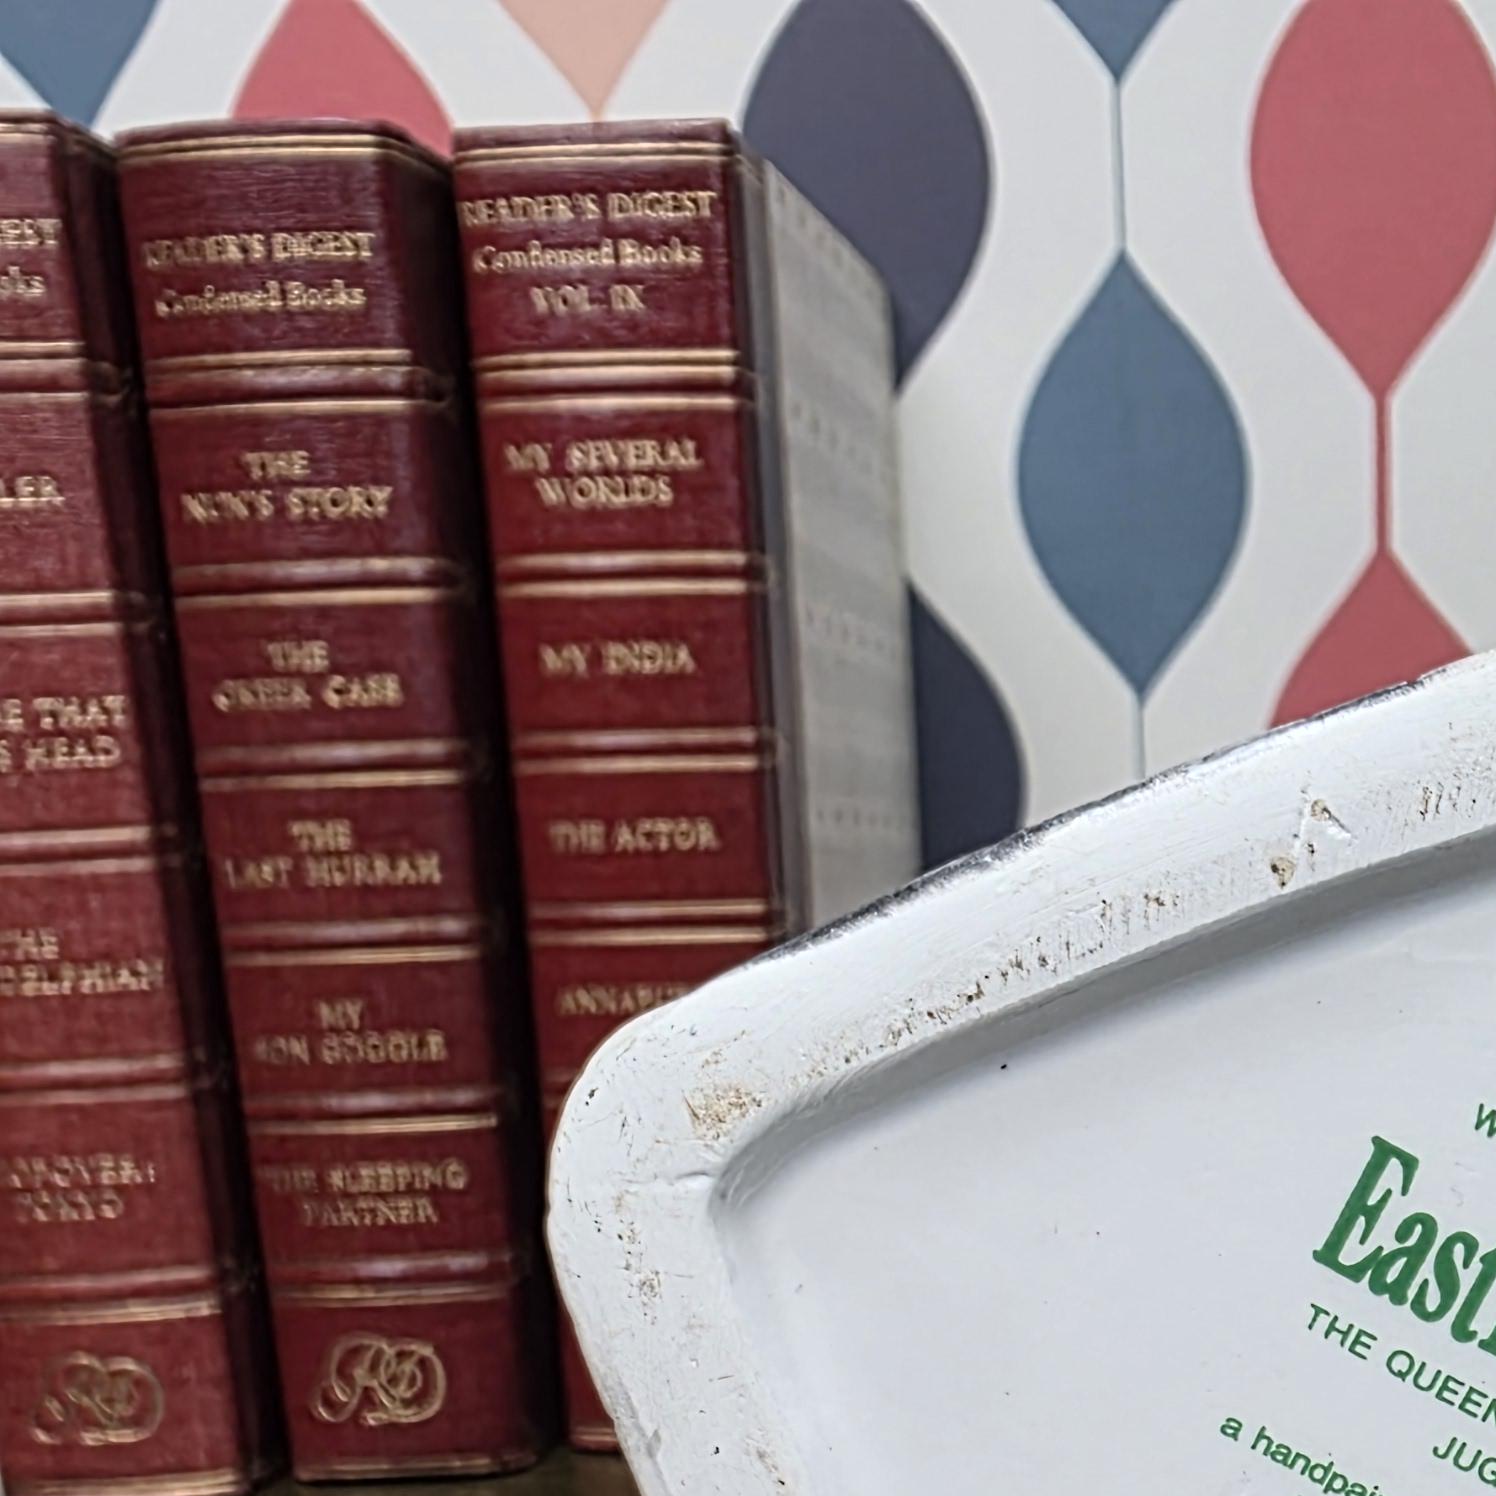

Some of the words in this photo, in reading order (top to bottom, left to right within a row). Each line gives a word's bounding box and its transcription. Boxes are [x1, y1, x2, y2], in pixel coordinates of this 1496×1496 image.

[607, 190, 717, 222] DIGEST
[473, 238, 615, 273] Condensed
[617, 236, 703, 267] Books
[565, 437, 704, 473] SEVERAL
[613, 816, 721, 852] ACTOR
[1306, 1303, 1378, 1360] THE
[1219, 1416, 1243, 1442] a
